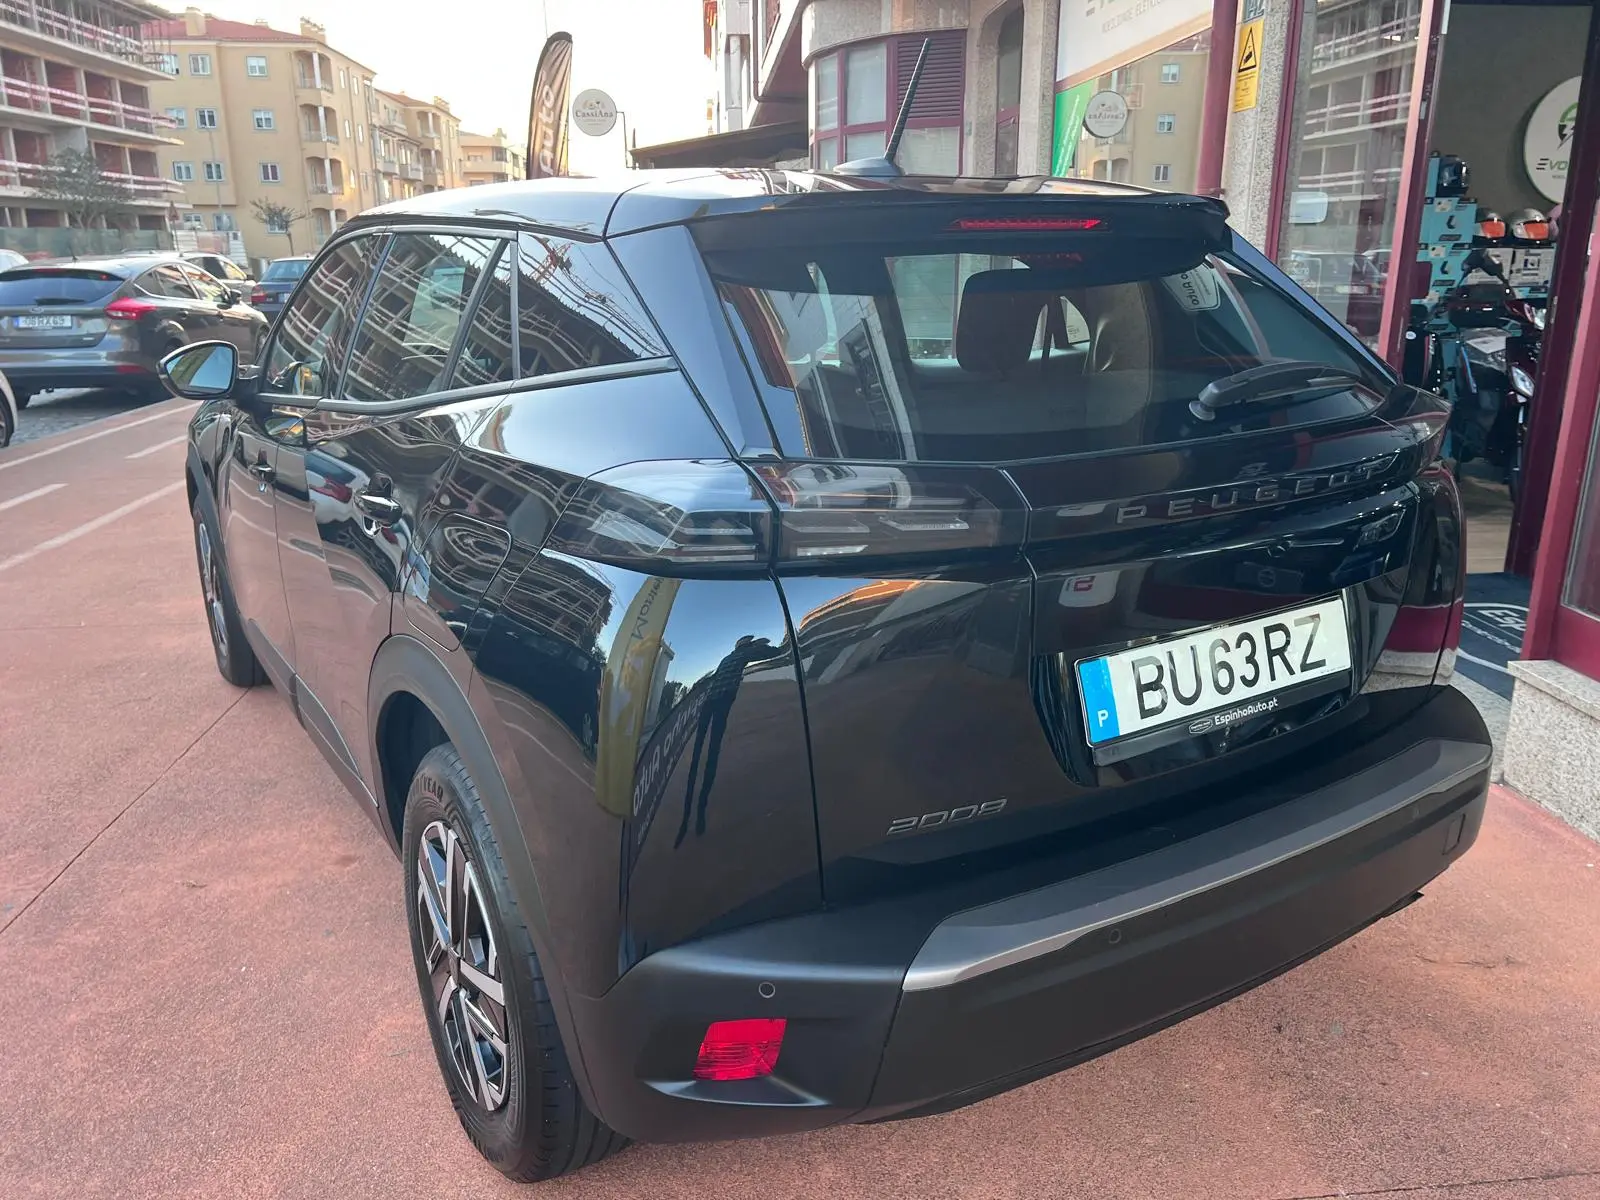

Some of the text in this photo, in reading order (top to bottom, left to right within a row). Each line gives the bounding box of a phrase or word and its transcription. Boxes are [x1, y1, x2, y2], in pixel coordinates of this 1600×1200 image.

[575, 109, 614, 118] CassiAna
[1116, 461, 1380, 524] PEUGEOT
[1131, 613, 1327, 720] BU63RZ
[1097, 710, 1109, 728] P
[1214, 697, 1279, 726] EspinhoAuto.pt
[886, 798, 1008, 836] 2008
